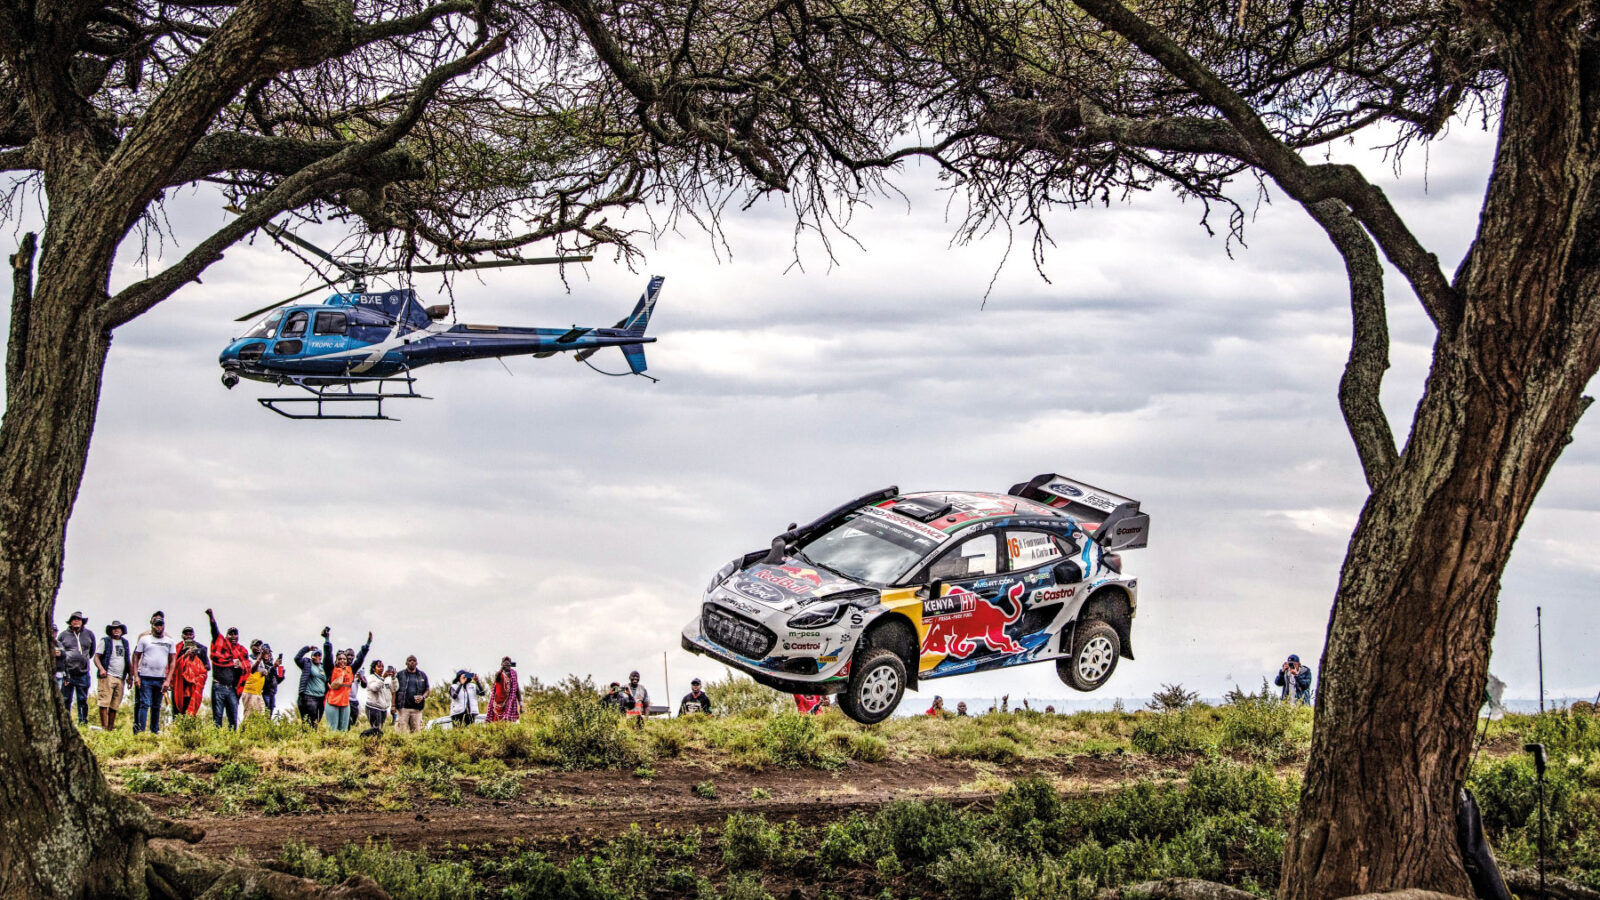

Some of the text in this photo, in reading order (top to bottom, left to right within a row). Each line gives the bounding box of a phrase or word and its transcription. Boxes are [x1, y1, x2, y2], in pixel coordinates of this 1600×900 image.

[1007, 537, 1020, 558] 16
[741, 583, 778, 598] Ford
[1043, 587, 1075, 601] Castrol
[924, 594, 975, 612] KENYA HY
[791, 642, 820, 650] Castrol
